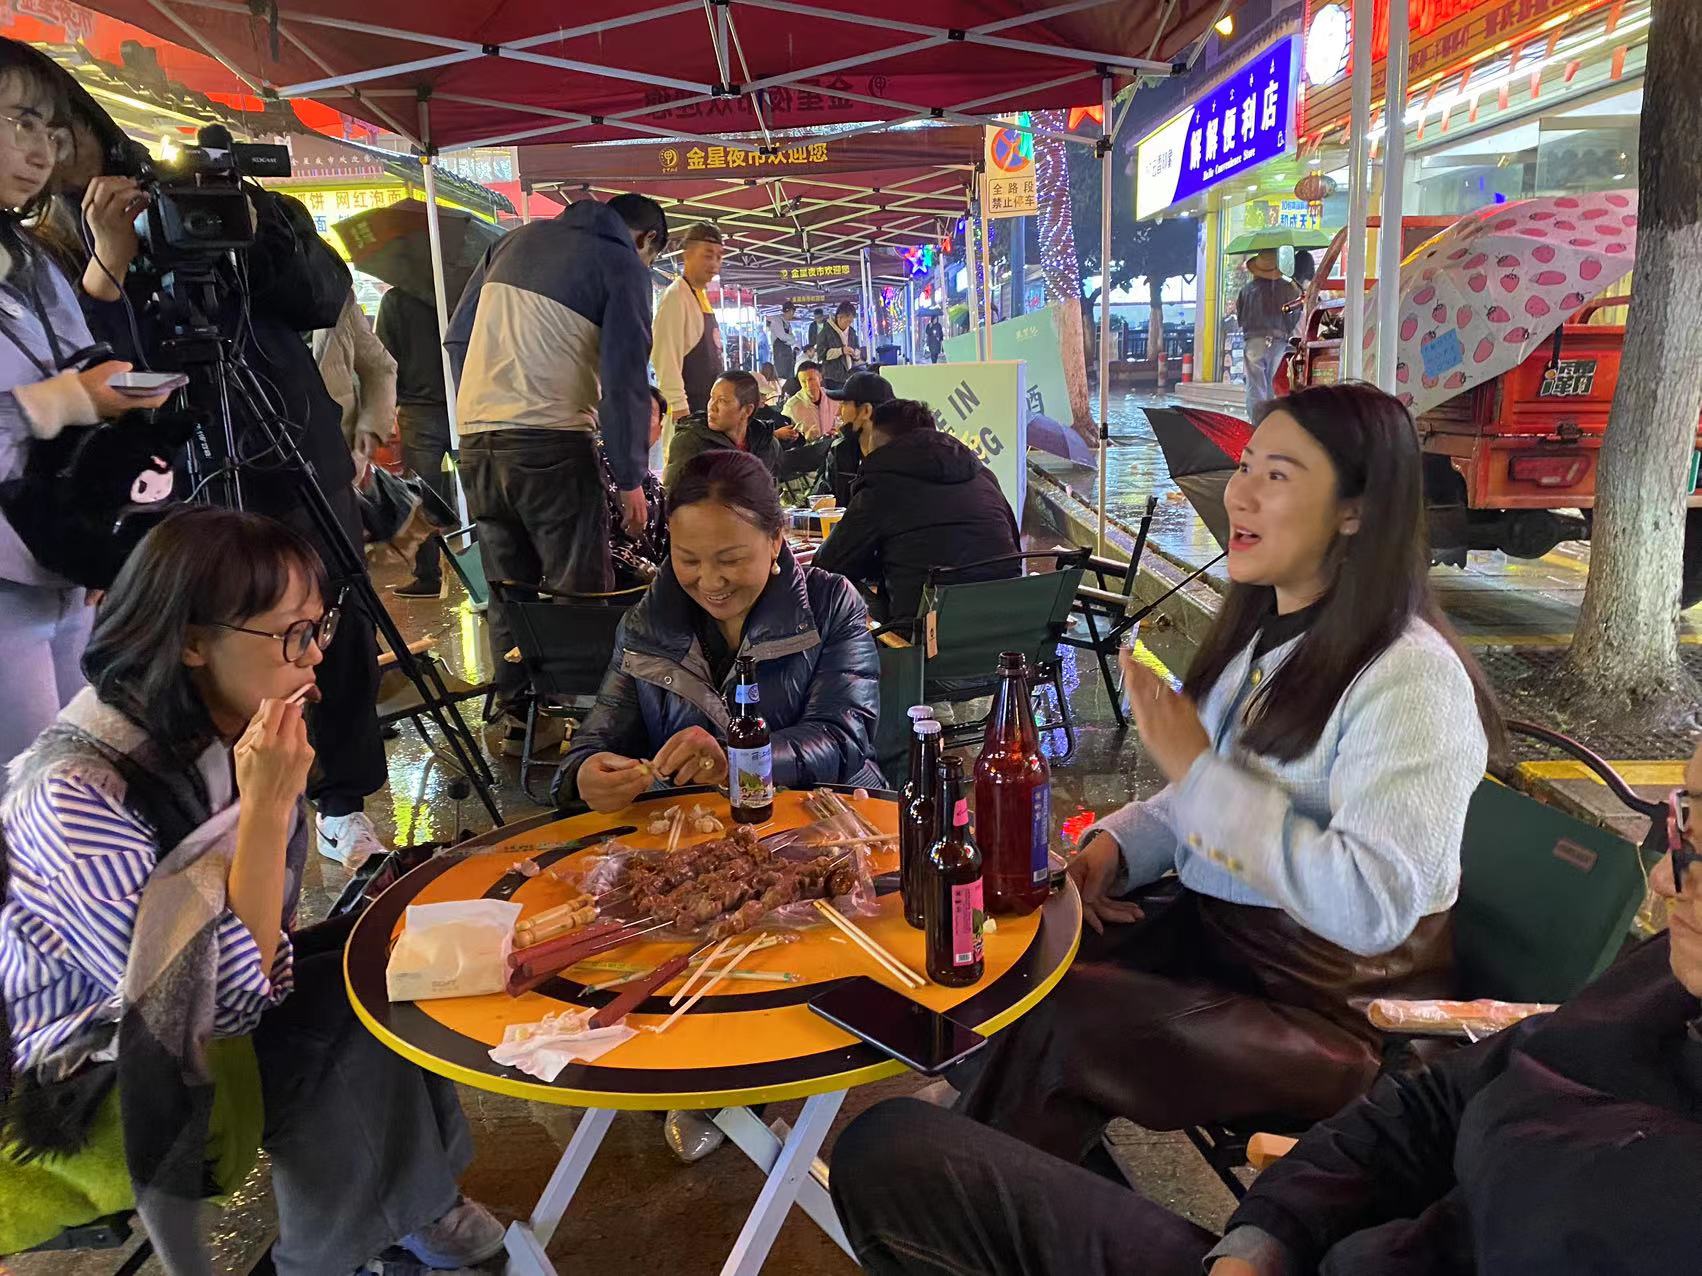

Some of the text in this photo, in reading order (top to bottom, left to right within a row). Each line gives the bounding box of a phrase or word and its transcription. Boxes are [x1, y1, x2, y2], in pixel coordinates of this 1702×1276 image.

[686, 142, 828, 170] 金星夜市欢迎您
[993, 181, 1033, 196] 全路段
[992, 195, 1035, 209] 禁止停车
[948, 380, 981, 421] IN
